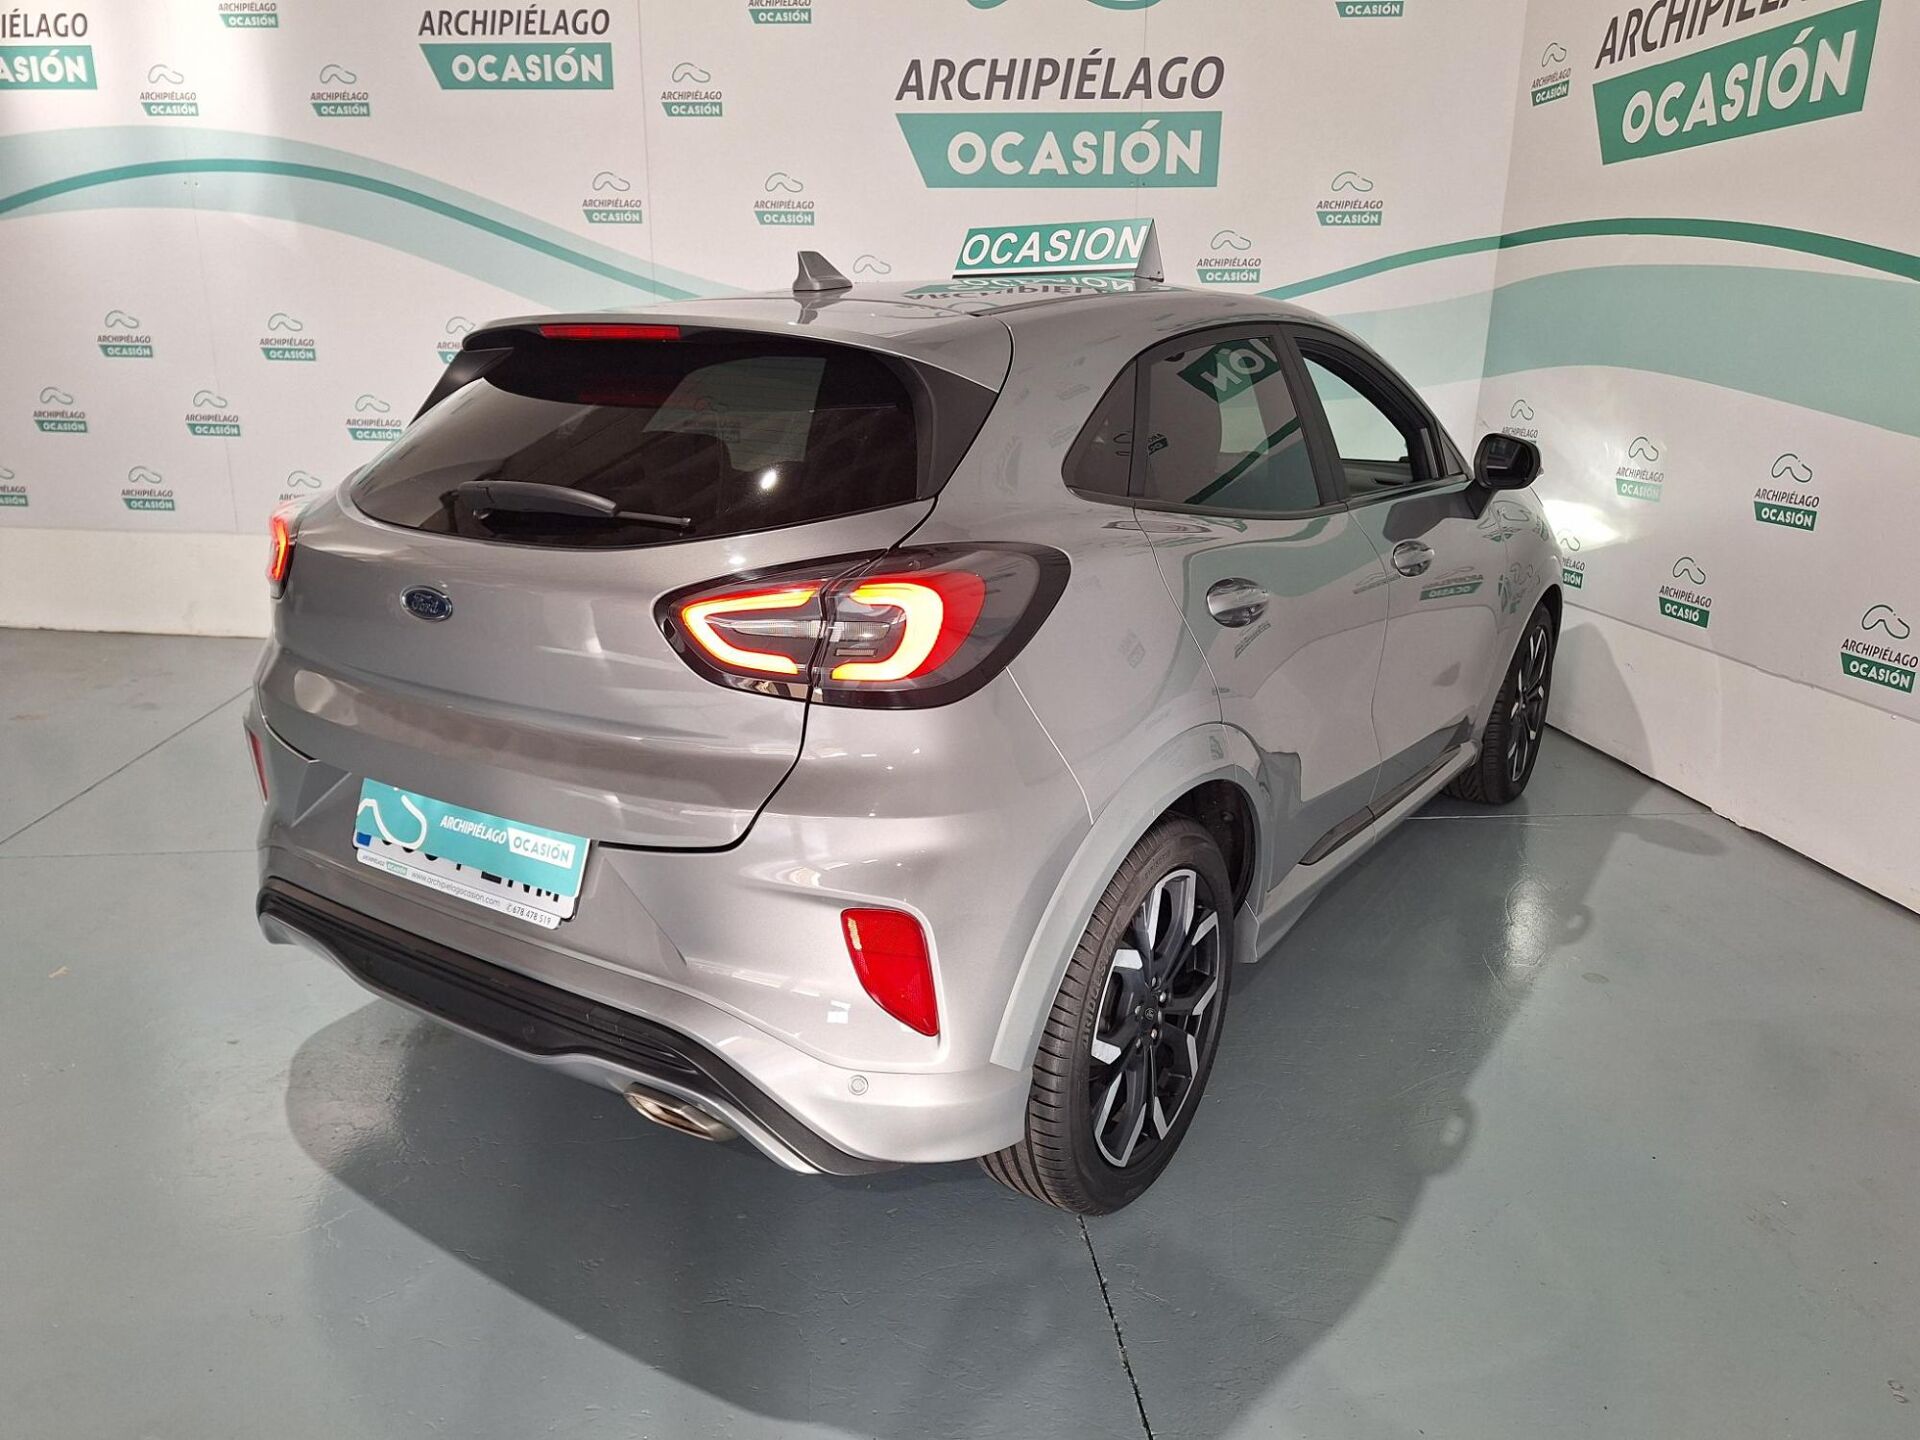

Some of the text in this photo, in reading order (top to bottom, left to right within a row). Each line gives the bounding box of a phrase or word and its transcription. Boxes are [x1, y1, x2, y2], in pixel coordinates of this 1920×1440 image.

[1345, 2, 1400, 15] OCASIÓN
[228, 14, 276, 26] OCASIÓN
[418, 4, 610, 36] ARCHIPIÉLAGO
[758, 9, 809, 22] OCASIÓN
[451, 47, 604, 82] OCASIÓN
[895, 48, 1225, 101] ARCHIPIÉLAGO
[1622, 26, 1857, 144] OCASIÓN
[139, 91, 197, 101] ARCHIPIÉLAGO
[310, 90, 369, 101] ARCHIPIÉLAGO
[660, 89, 722, 101] ARCHIPIÉLAGO
[150, 103, 197, 115] OCASIÓN
[321, 103, 368, 115] OCASIÓN
[670, 102, 721, 115] OCASIÓN
[947, 120, 1203, 175] OCASIÓN
[582, 198, 642, 209] ARCHIPIÉLAGO
[753, 198, 814, 210] ARCHIPIÉLAGO
[1316, 199, 1384, 209] ARCHIPIÉLAGO
[592, 210, 640, 222] OCASIÓN
[763, 211, 812, 224] OCASIÓN
[1326, 212, 1379, 224] OCASIÓN
[960, 225, 1149, 265] OCASION
[1196, 257, 1262, 267] ARCHIPIÉLAGO
[1206, 270, 1257, 281] OCASIÓN
[1754, 487, 1820, 507] ARCHIPIÉLAGO
[1761, 509, 1813, 527] OCASIÓN
[1659, 585, 1712, 608] ARCHIPIÉLAGO
[1841, 638, 1919, 668] ARCHIPIÉLAGO
[1849, 660, 1911, 689] OCASIÓN
[440, 814, 570, 863] ARCHIPIÉLAGO OCASIÓN
